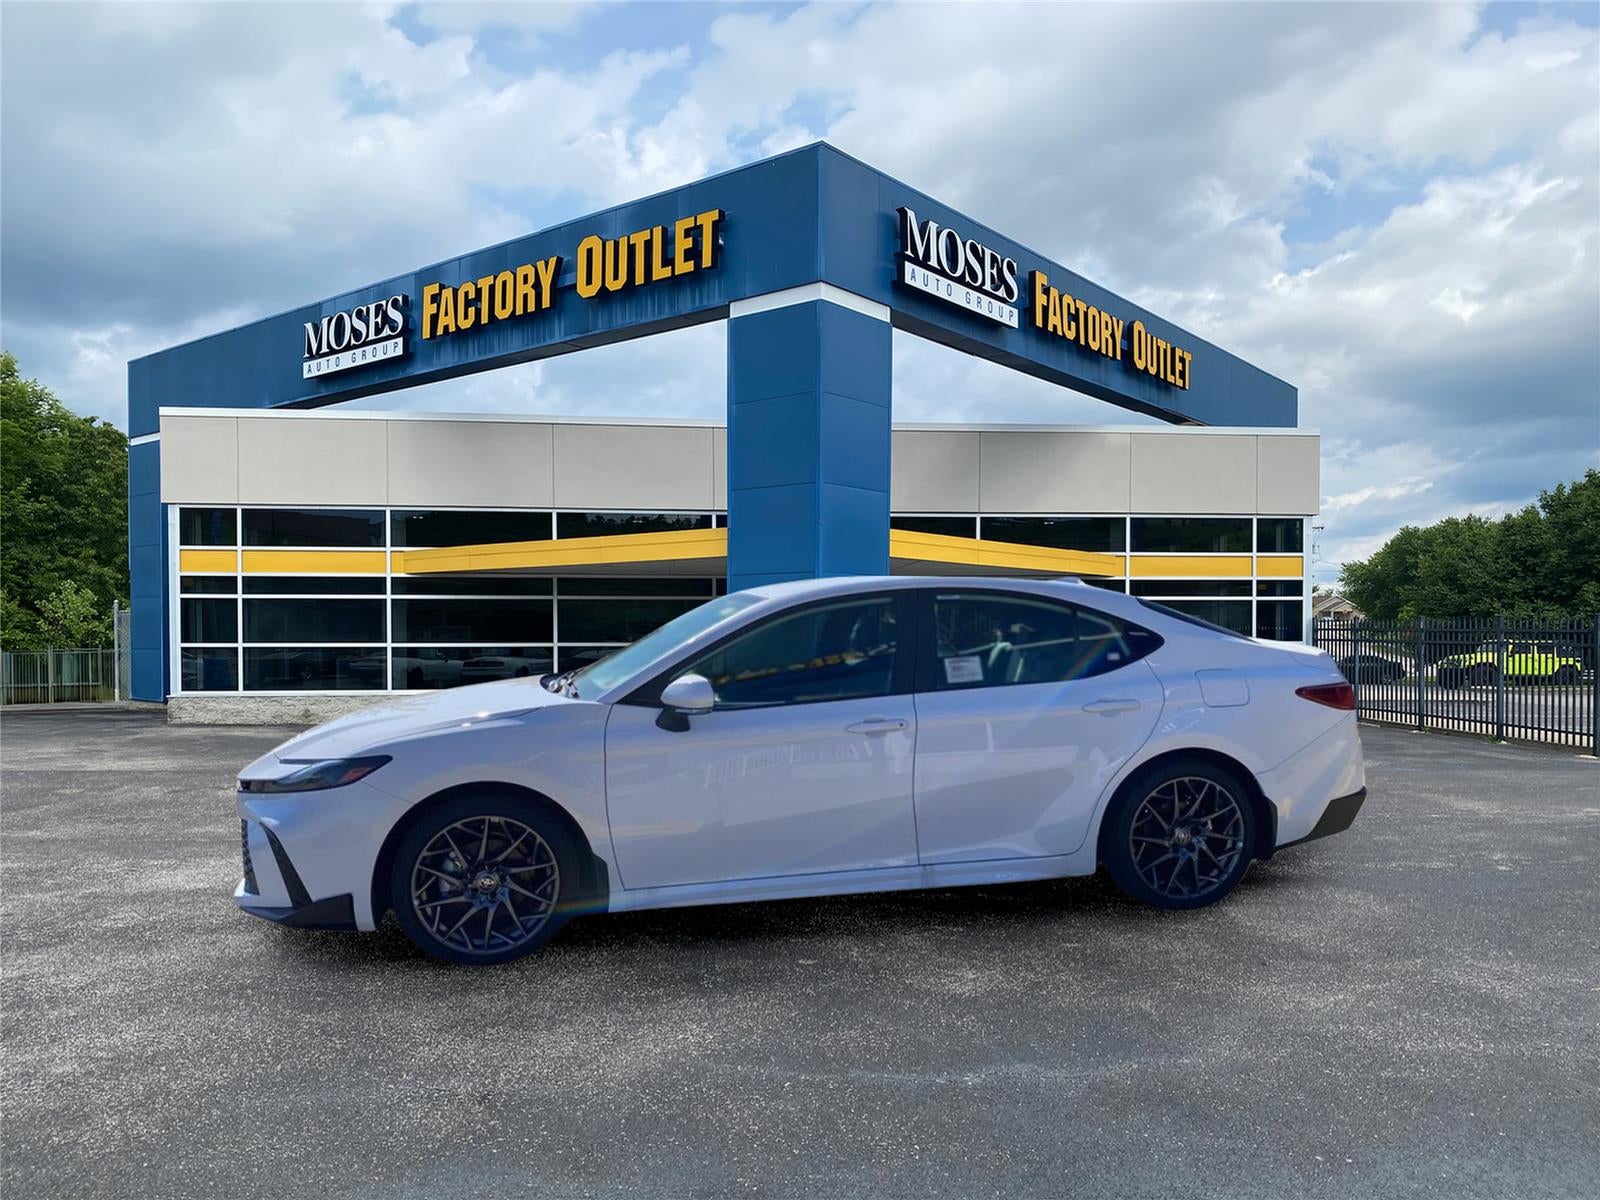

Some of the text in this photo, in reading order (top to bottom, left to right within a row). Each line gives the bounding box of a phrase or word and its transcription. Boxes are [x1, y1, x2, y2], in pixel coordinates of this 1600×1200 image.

[422, 208, 720, 340] FACTORY OUTLET
[903, 207, 1019, 303] MOSES
[910, 268, 1015, 321] AUTO GROUP
[303, 294, 404, 358] MOSES
[306, 341, 399, 375] AUTO GROUP
[1034, 270, 1192, 390] FACTORY OUTLET
